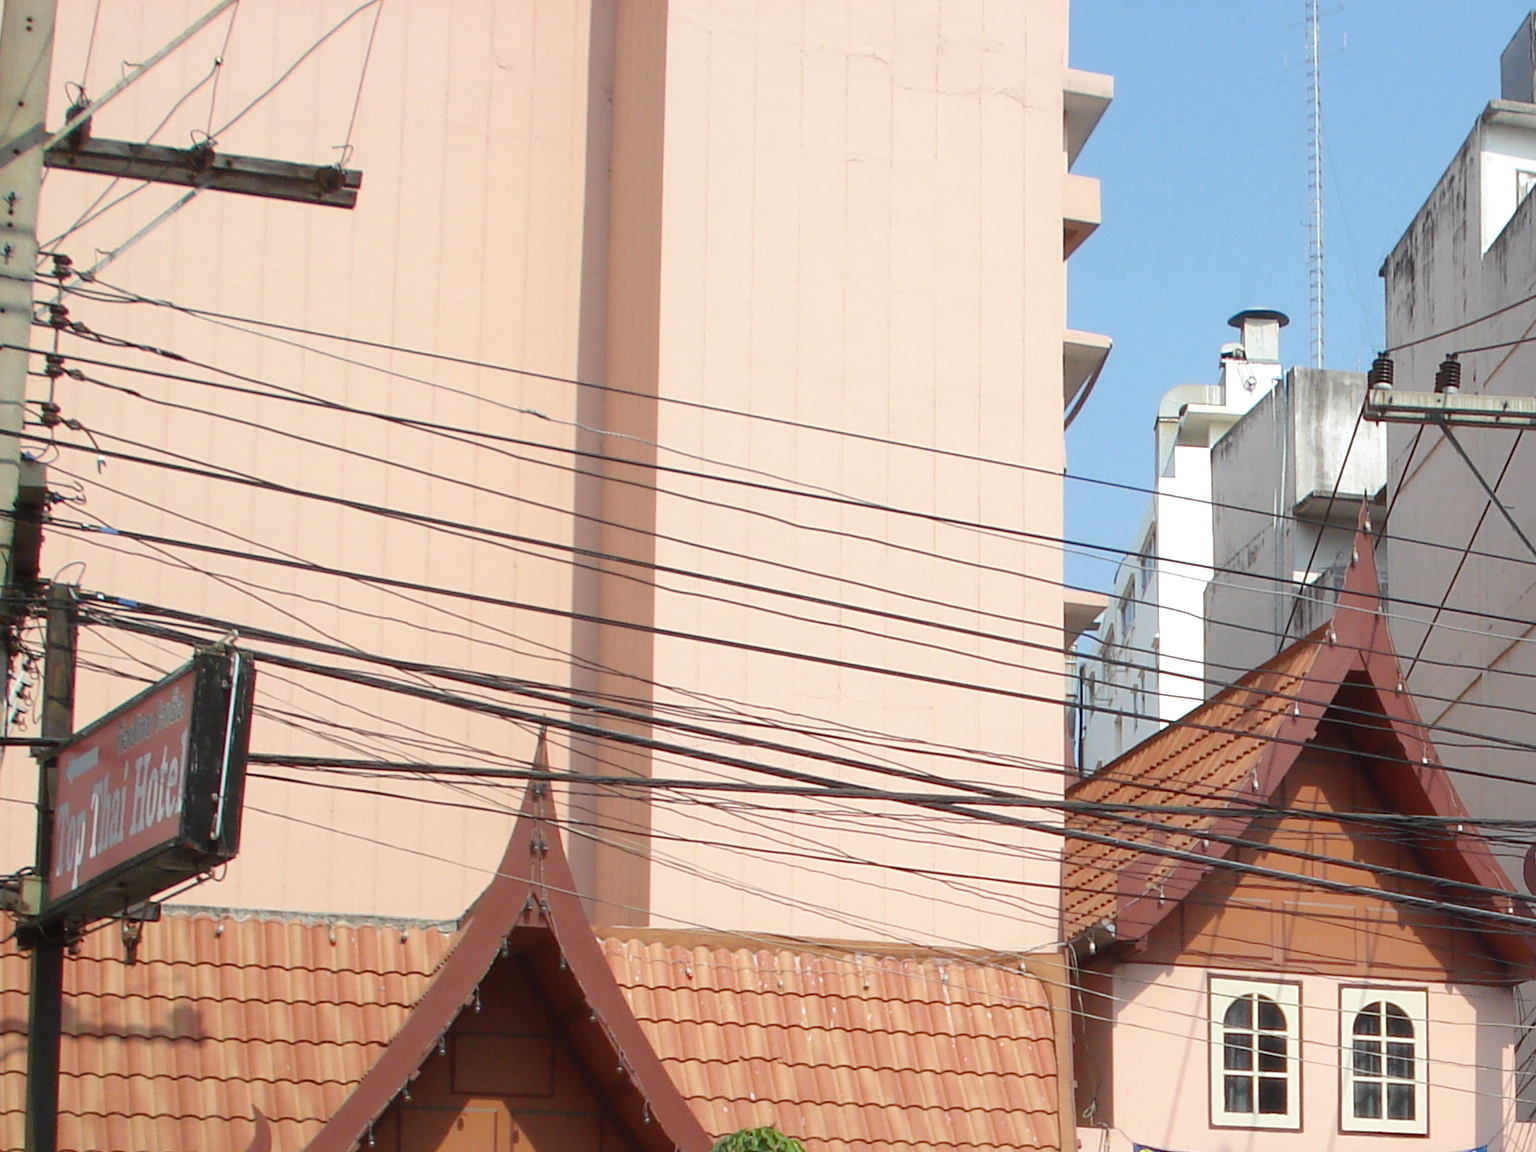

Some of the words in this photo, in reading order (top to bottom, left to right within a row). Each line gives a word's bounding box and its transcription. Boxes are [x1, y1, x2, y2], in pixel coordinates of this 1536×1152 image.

[56, 801, 86, 891] Top
[89, 760, 129, 859] Thai
[129, 727, 189, 836] Hotel
